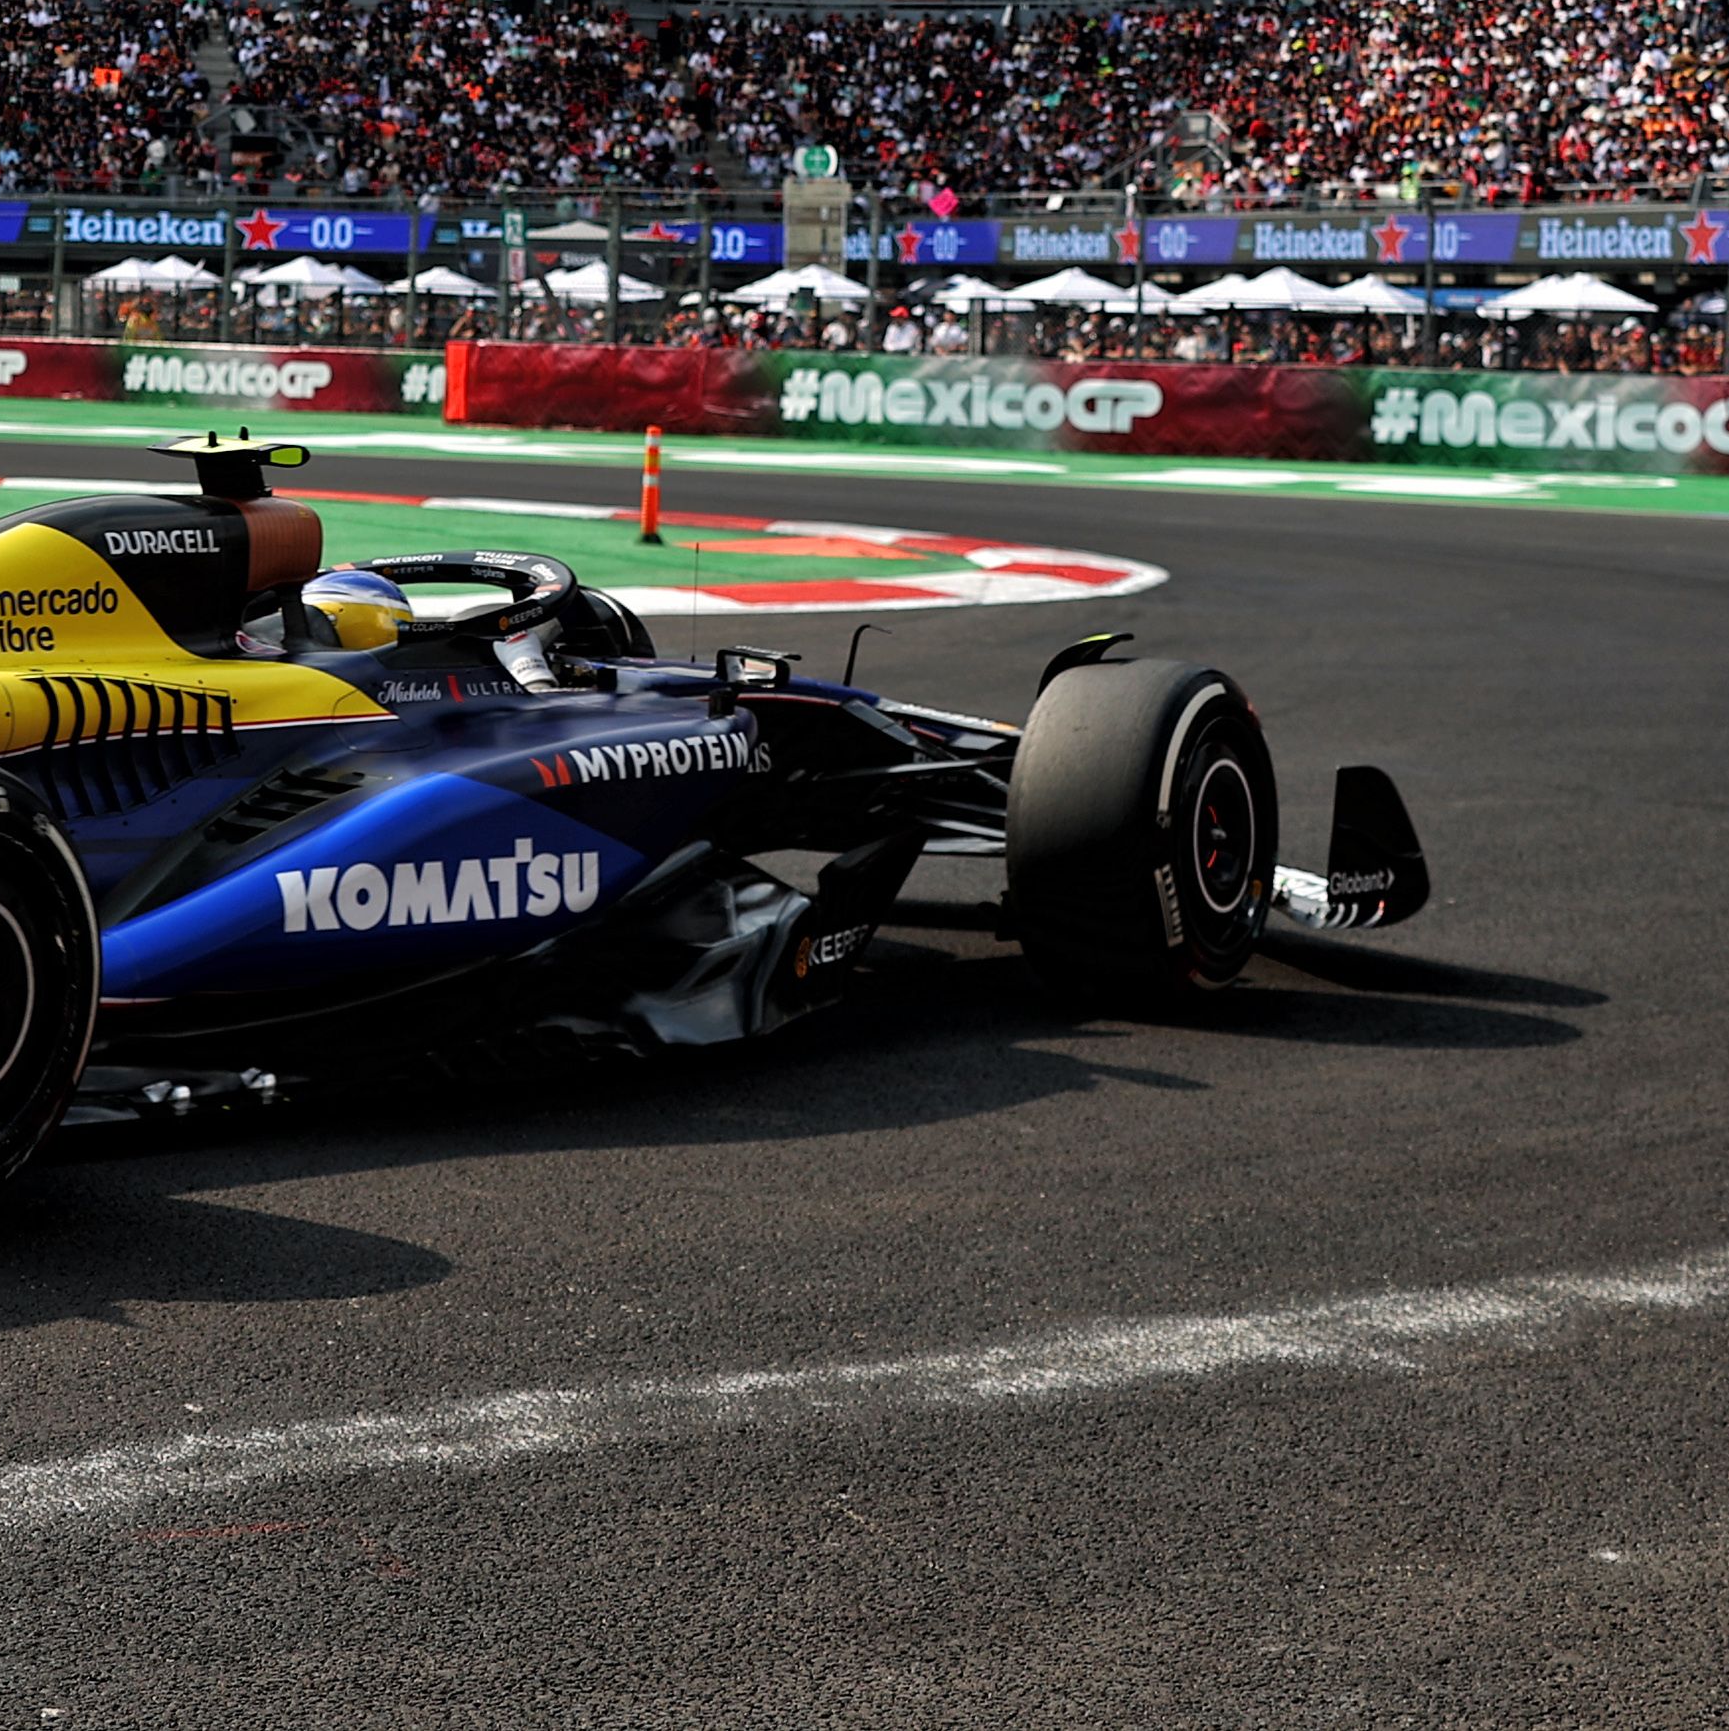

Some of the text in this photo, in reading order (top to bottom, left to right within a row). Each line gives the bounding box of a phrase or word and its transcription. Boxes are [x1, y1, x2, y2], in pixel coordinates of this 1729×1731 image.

[310, 216, 355, 249] 0.0
[124, 355, 332, 400] #MexicoGP
[780, 369, 1163, 434] #MexicoGP
[105, 528, 221, 556] DURACELL
[411, 622, 456, 631] COLAPINTO
[508, 606, 544, 625] KEEPER
[377, 679, 525, 704] Michelob ULTRA
[568, 731, 750, 784] MYPROTEIN
[276, 838, 600, 933] KOMATSU
[1330, 868, 1387, 896] Globant
